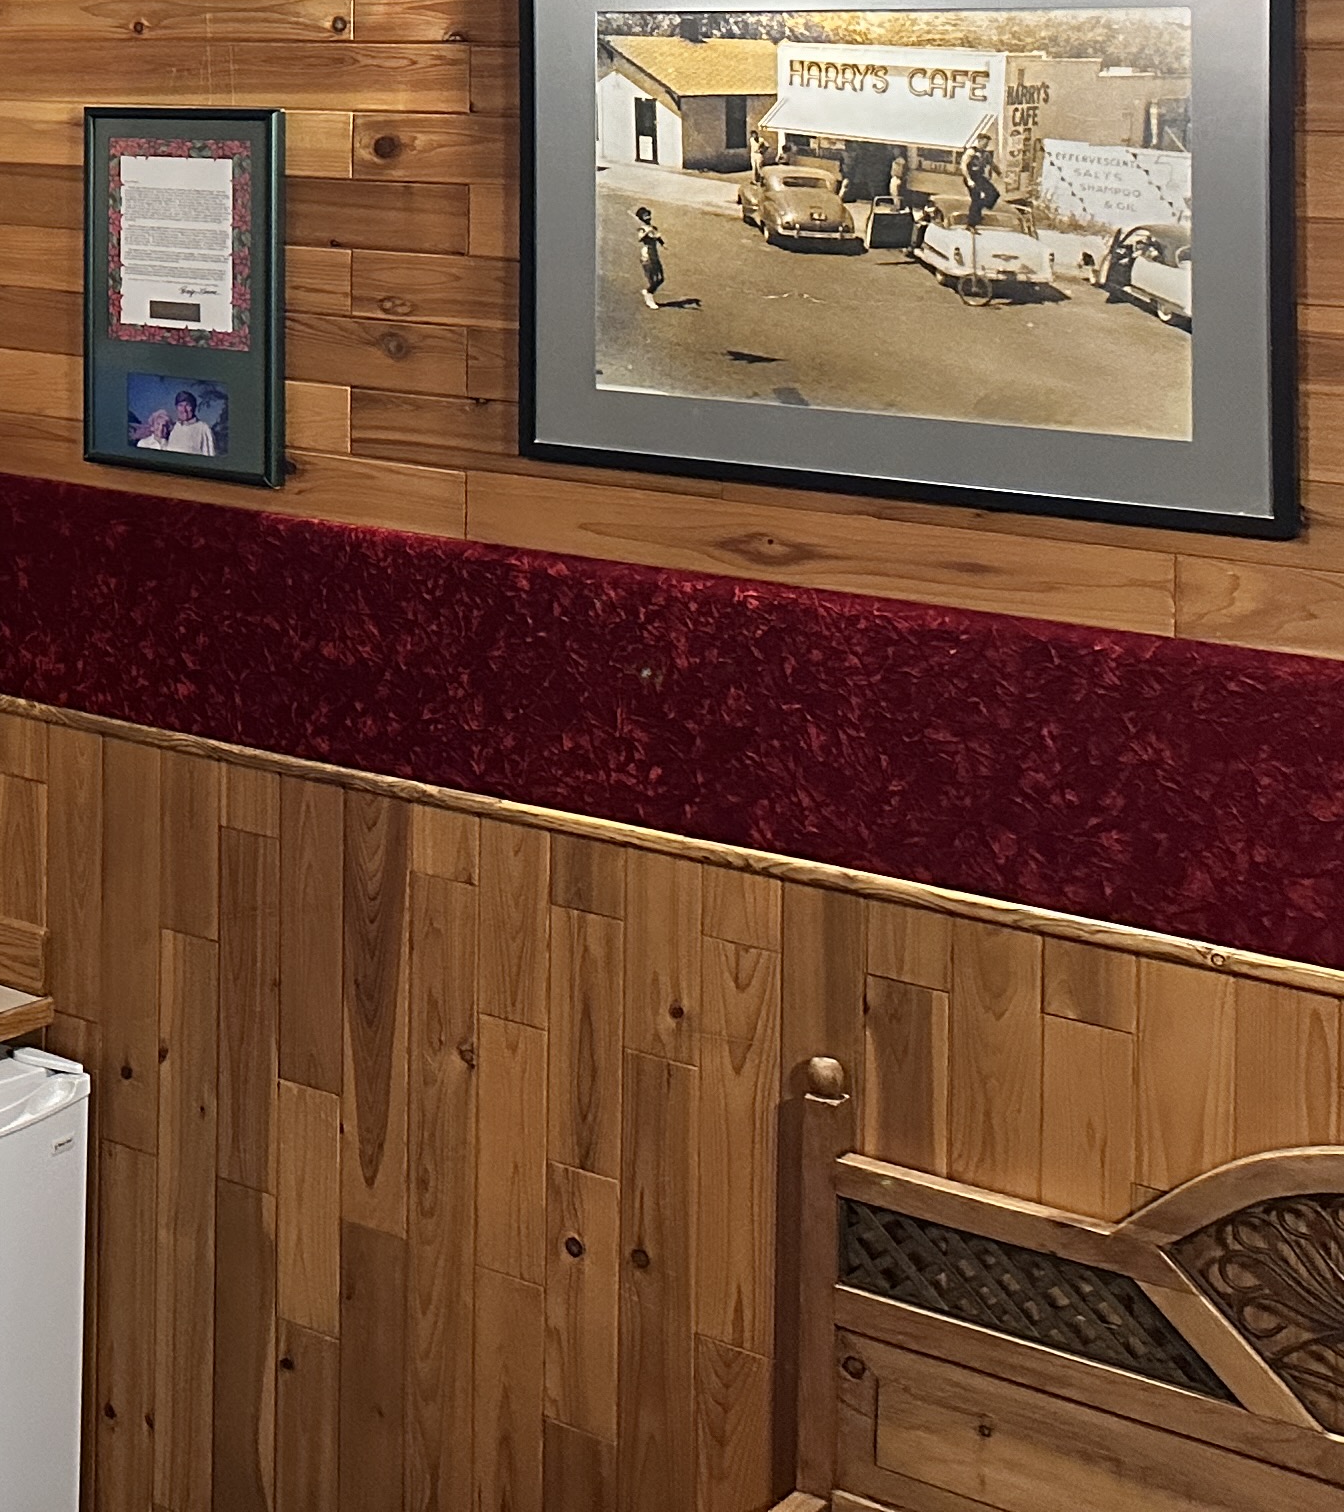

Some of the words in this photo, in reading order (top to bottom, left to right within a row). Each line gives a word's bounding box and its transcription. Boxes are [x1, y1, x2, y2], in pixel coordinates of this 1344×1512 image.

[788, 59, 890, 95] HARRY'S
[906, 67, 991, 102] CAFE
[1006, 81, 1050, 106] HARRY'S
[1011, 105, 1040, 127] CAFE
[1078, 182, 1143, 199] SHAMPOO
